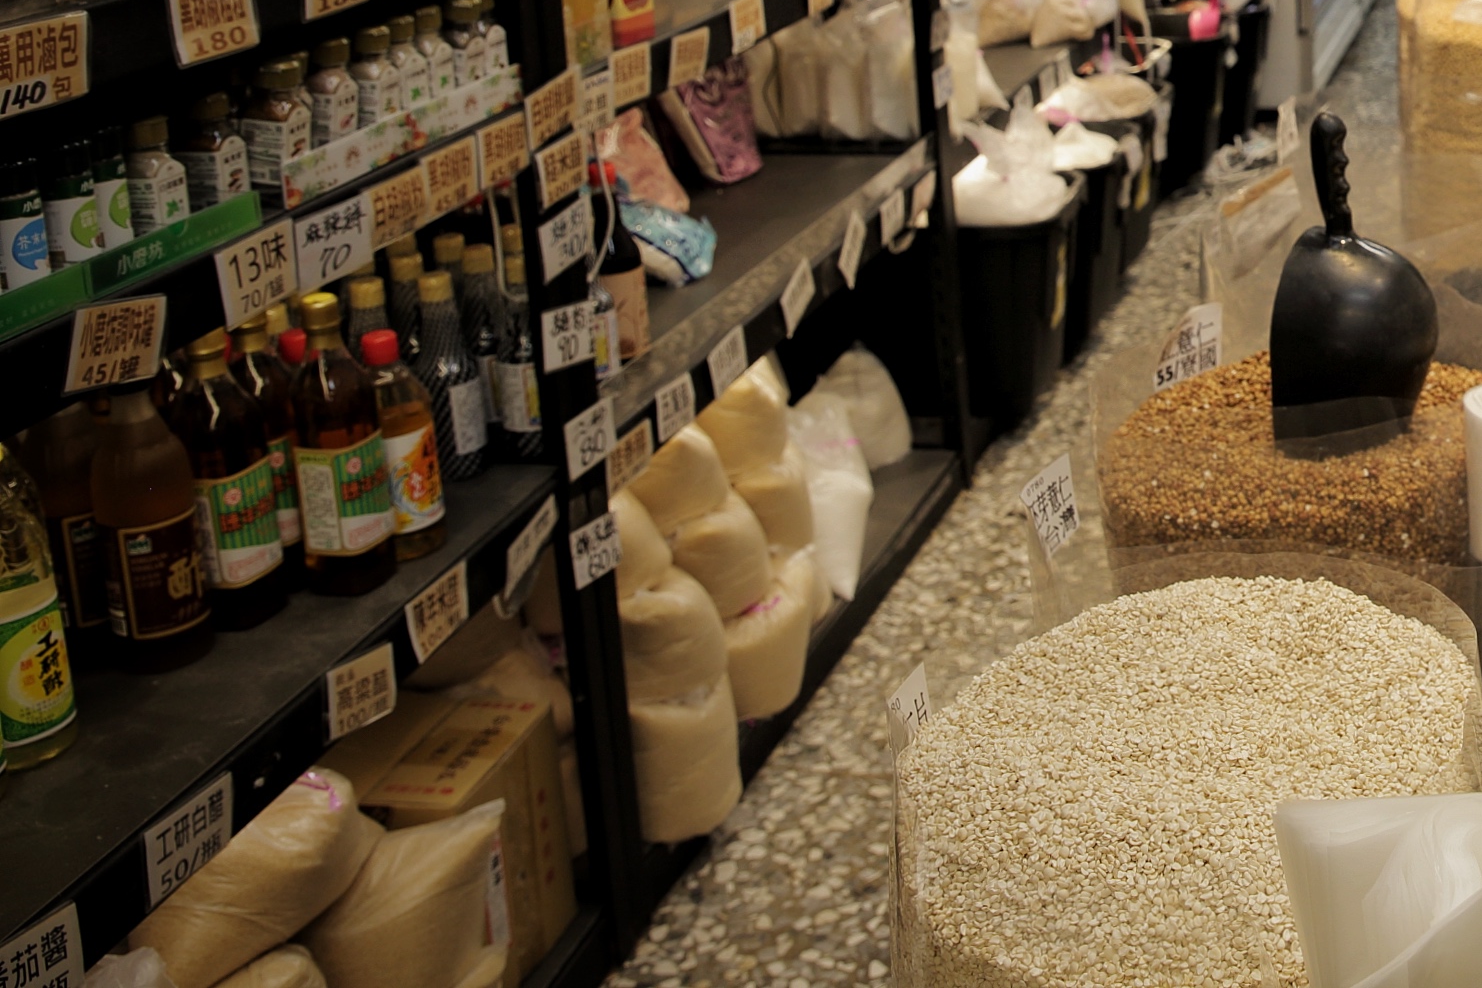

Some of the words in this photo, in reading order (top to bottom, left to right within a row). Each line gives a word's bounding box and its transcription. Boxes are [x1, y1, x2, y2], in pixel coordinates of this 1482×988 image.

[192, 26, 246, 58] 180
[0, 80, 46, 115] 140
[117, 241, 165, 277] 小磨坊
[229, 231, 287, 289] 13味
[319, 243, 352, 280] 70
[82, 354, 141, 386] 45/罐
[35, 630, 64, 696] 工研醋
[155, 788, 224, 866] 工研白醋
